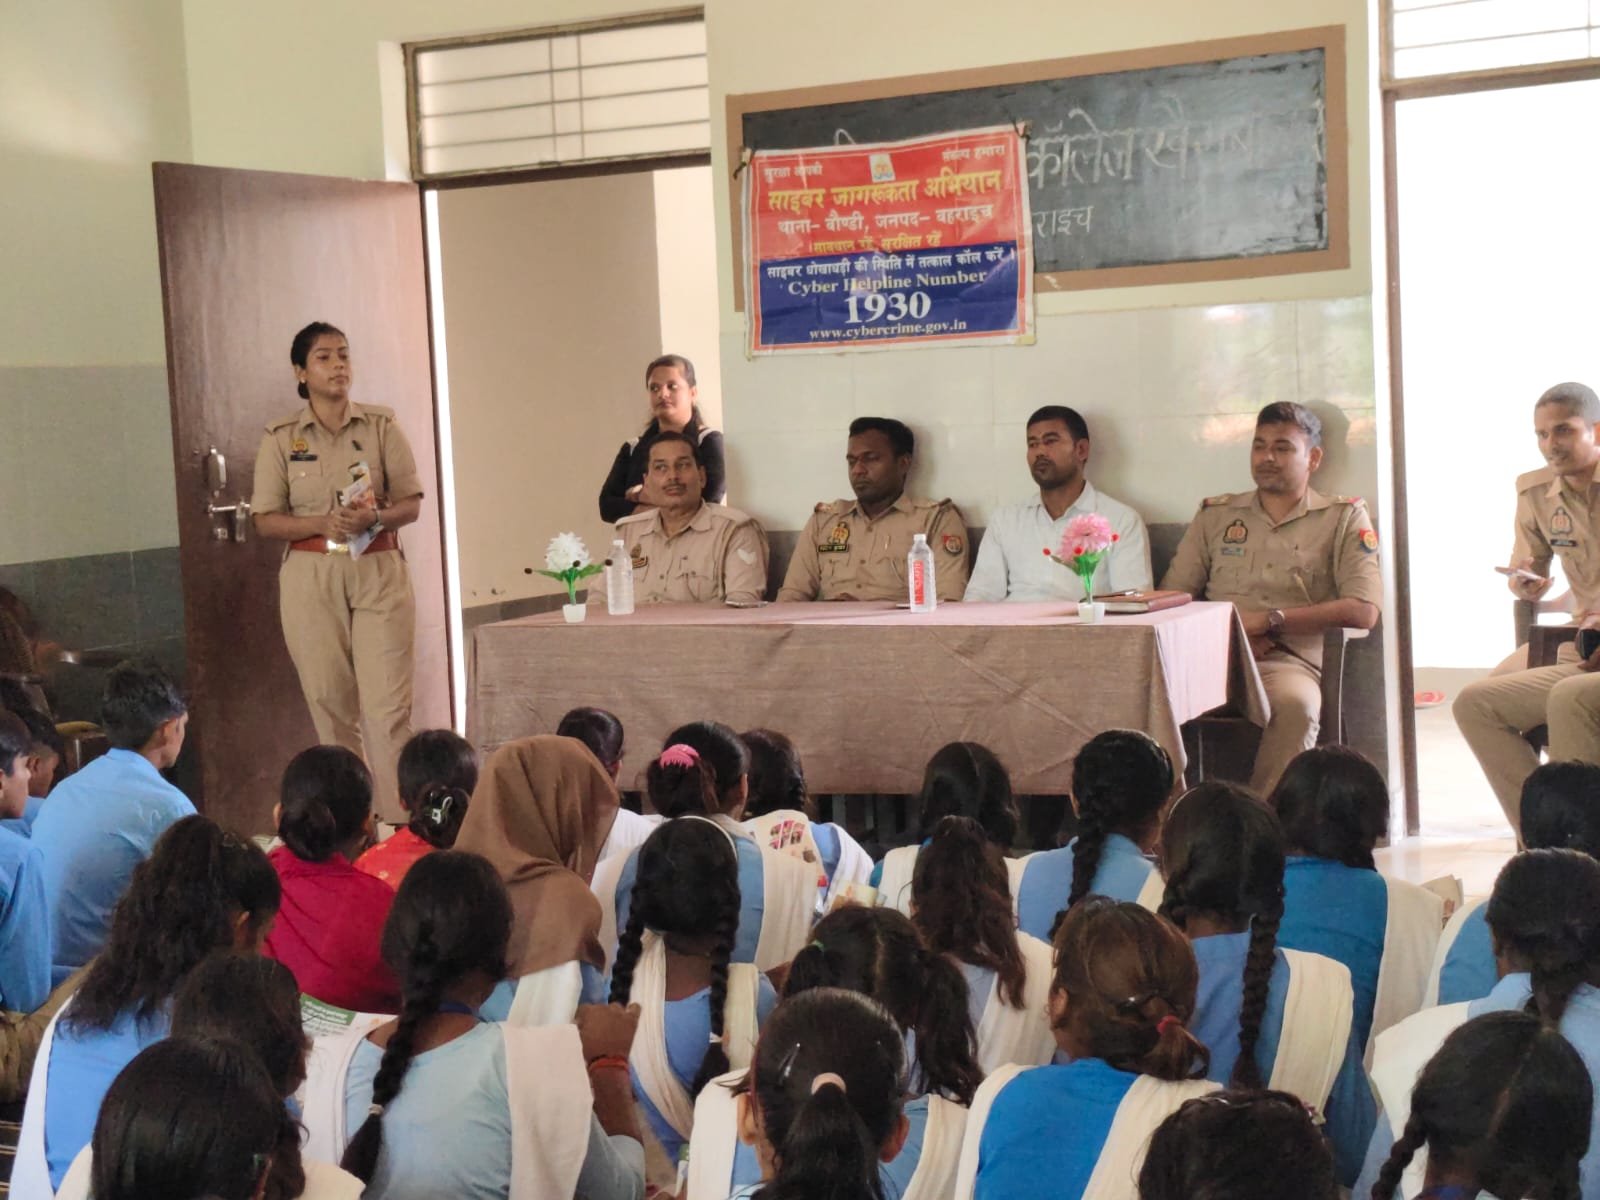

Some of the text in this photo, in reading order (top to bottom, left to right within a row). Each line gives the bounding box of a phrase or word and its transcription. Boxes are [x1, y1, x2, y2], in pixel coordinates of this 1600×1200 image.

[768, 166, 1002, 214] साइबर जागरूकता अभियान
[935, 204, 992, 225] बहराइच
[766, 265, 803, 280] साइबर
[854, 256, 869, 273] की
[872, 254, 902, 271] स्थिति
[905, 254, 915, 269] में
[918, 254, 952, 269] तत्काल
[956, 248, 982, 265] कॉल
[787, 270, 988, 297] Cyber Helpline Number
[844, 291, 932, 324] 1930
[809, 319, 968, 340] www.cybercrime.gov.in
